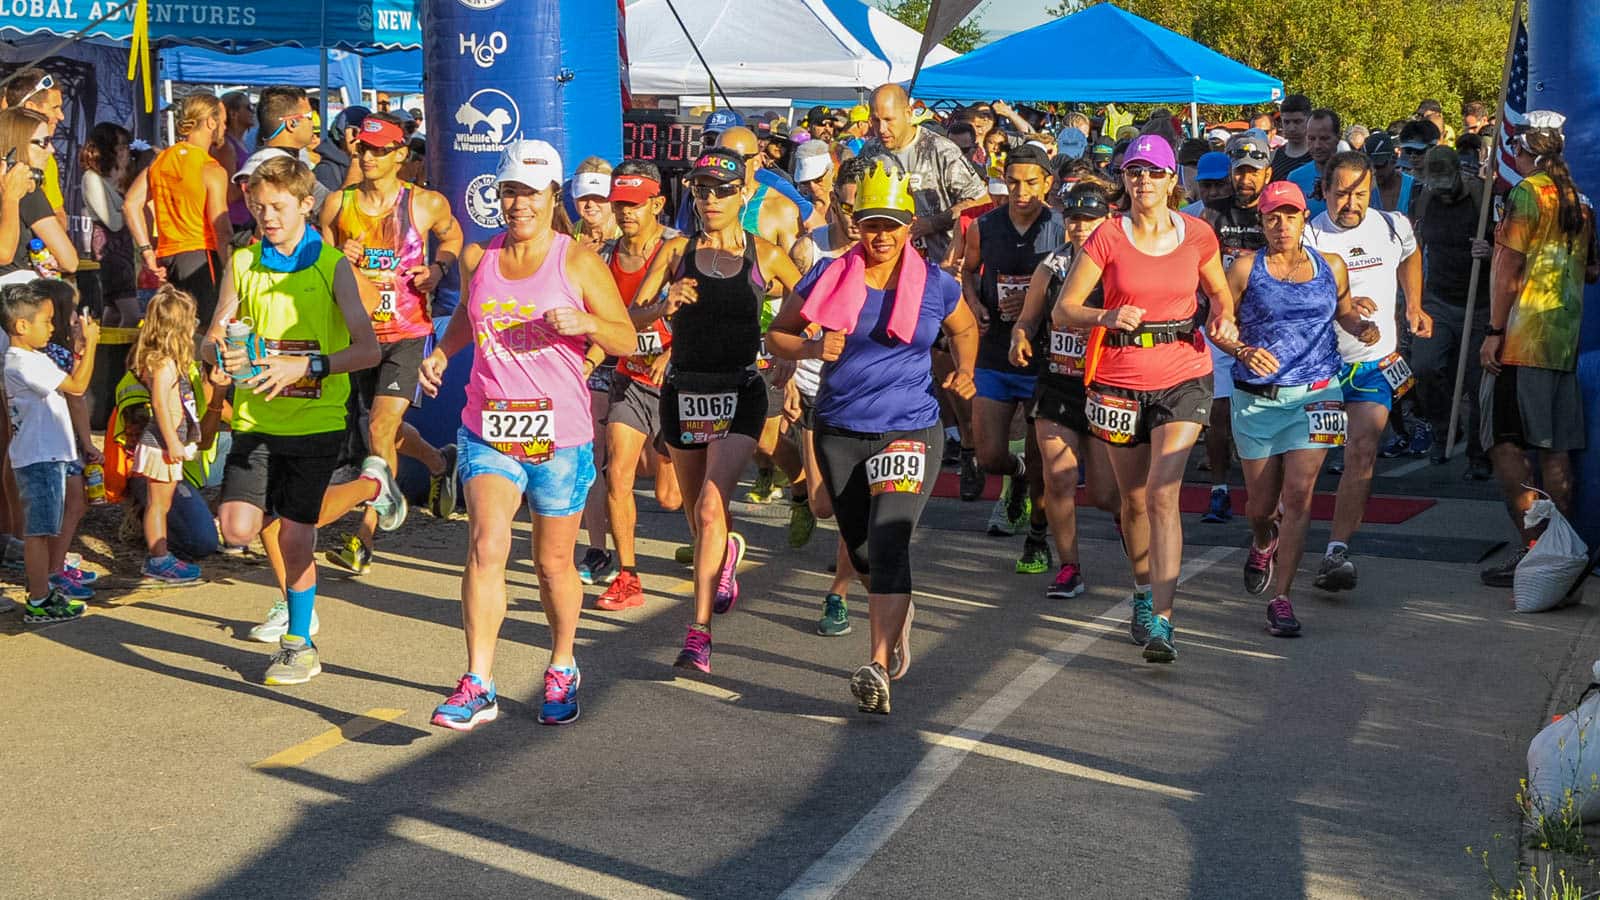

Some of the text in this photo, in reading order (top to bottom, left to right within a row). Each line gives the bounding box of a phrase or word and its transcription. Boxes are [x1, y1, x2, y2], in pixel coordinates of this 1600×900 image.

[0, 0, 78, 19] LOBAL
[378, 9, 412, 30] NEW
[461, 142, 505, 153] Waystatio
[1348, 256, 1383, 267] RATHON
[1054, 333, 1086, 355] 308
[684, 395, 733, 417] 3066
[1088, 402, 1131, 431] 3088
[488, 414, 550, 438] 3222
[870, 454, 919, 480] 3089
